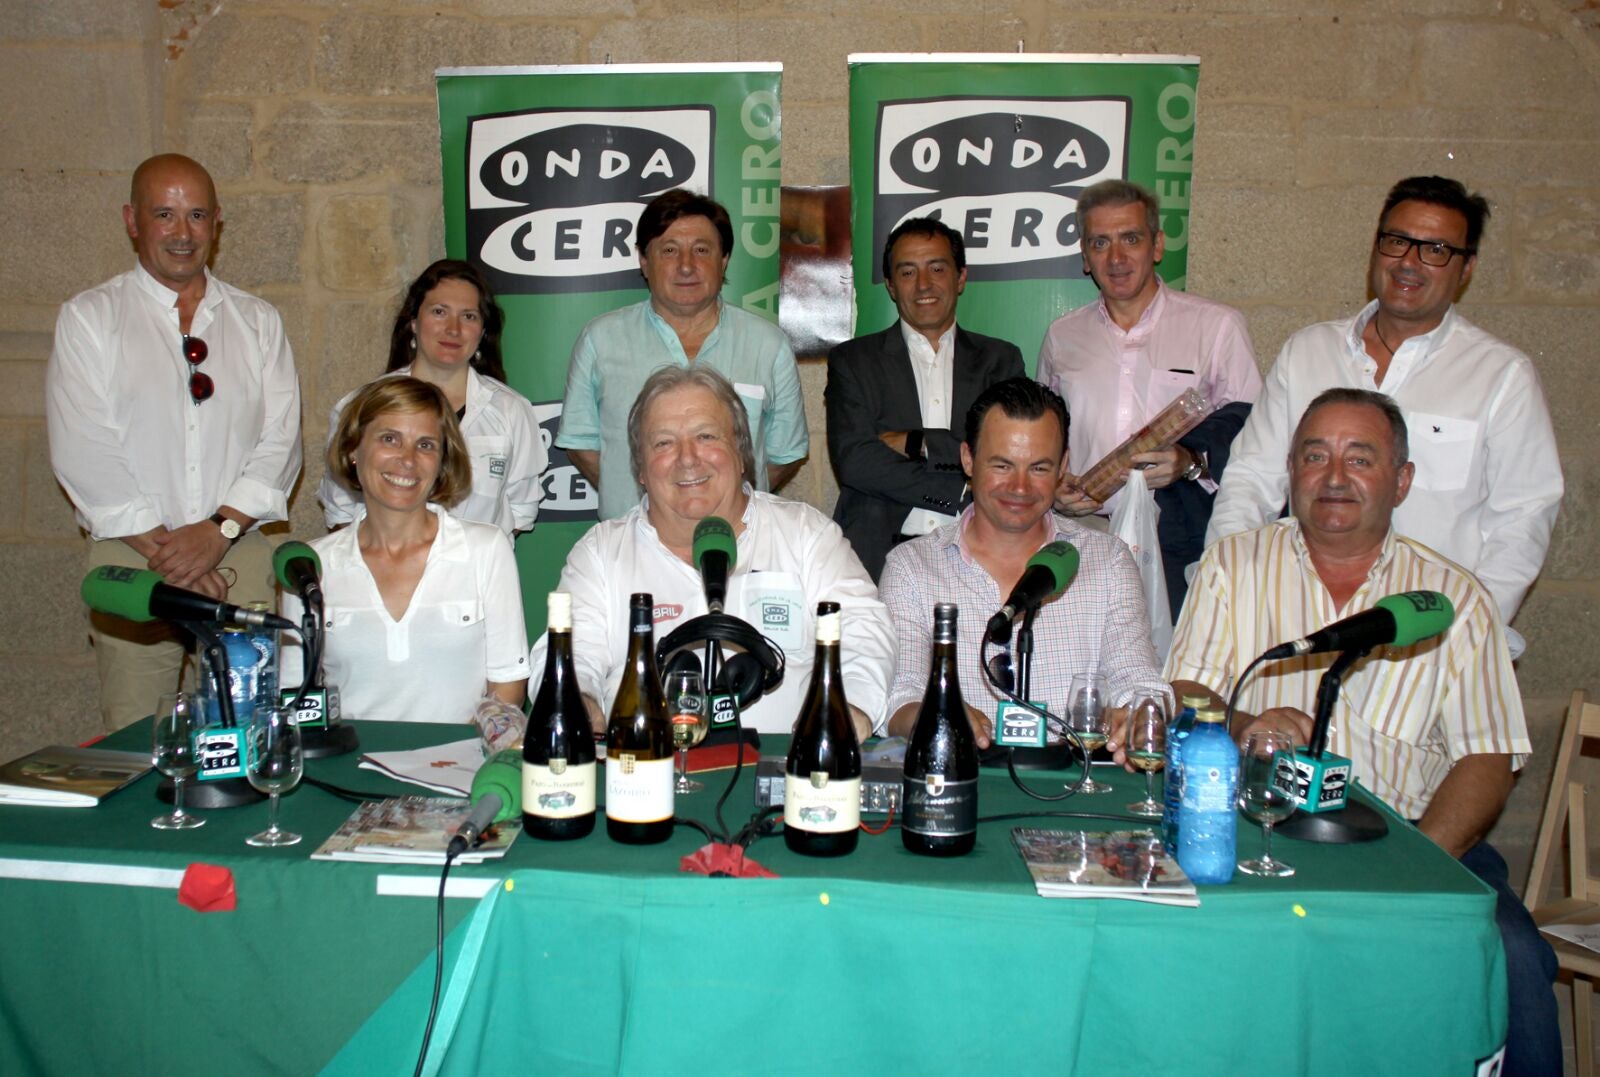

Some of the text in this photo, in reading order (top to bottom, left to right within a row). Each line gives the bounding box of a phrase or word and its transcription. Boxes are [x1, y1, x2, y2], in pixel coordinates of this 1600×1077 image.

[501, 149, 674, 186] ONDA
[741, 90, 781, 258] CERO
[912, 137, 1087, 172] ONDA
[1155, 82, 1197, 252] CERO
[510, 218, 633, 261] CER
[926, 208, 1081, 249] ERO
[541, 474, 587, 501] CE
[1003, 728, 1035, 736] CERO
